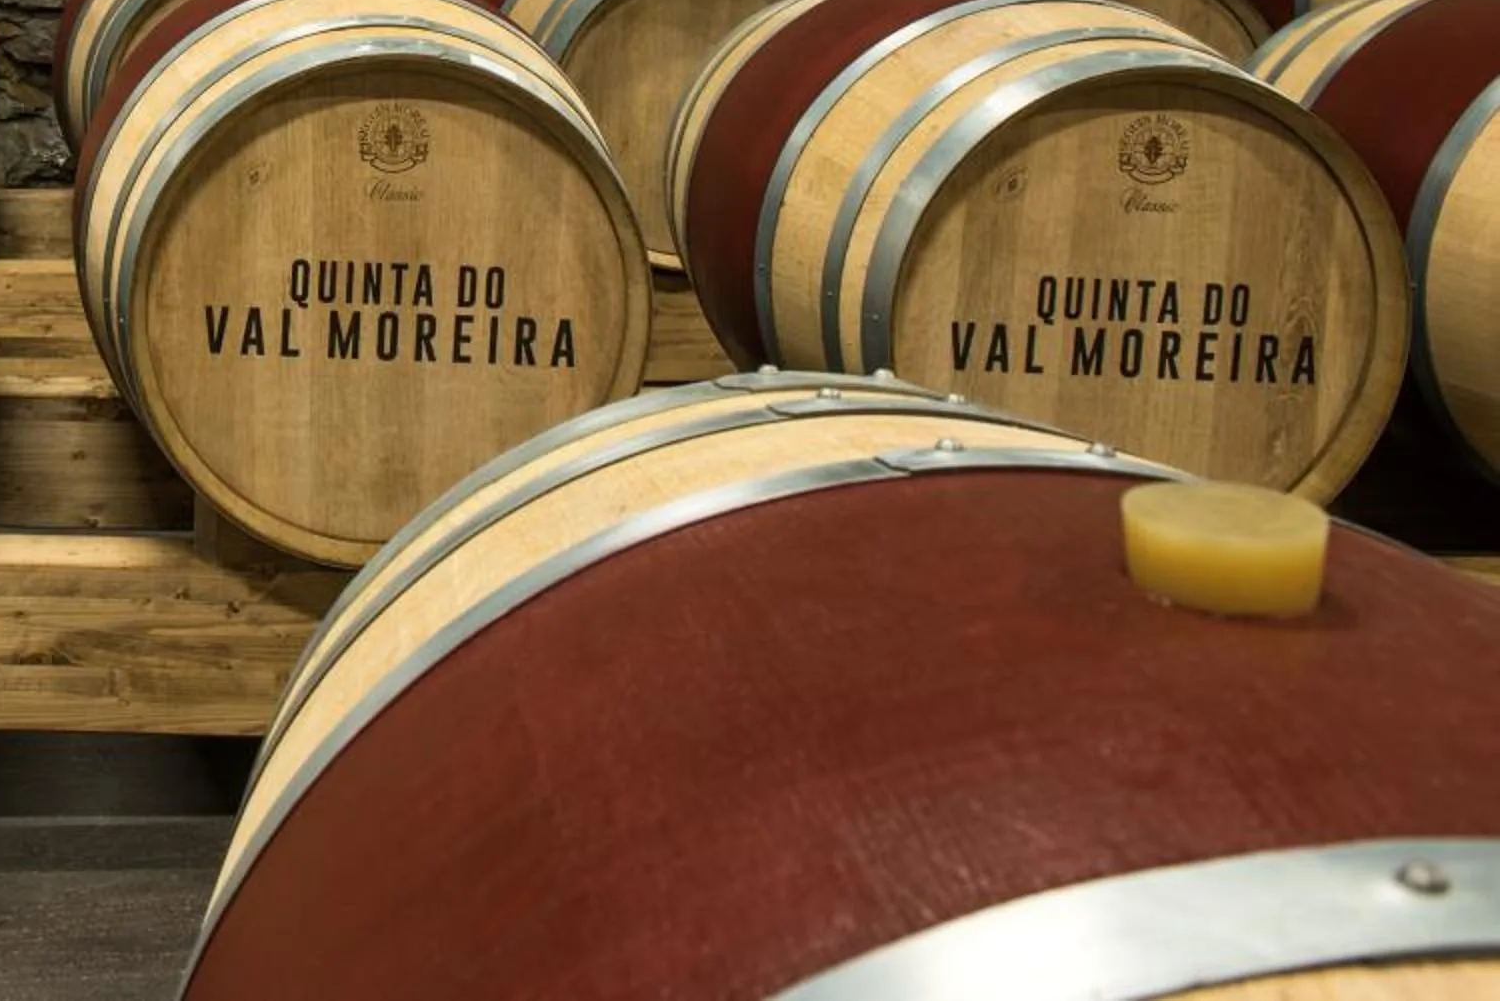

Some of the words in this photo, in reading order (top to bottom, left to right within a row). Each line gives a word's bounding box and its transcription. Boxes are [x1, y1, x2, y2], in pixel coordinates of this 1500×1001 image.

[290, 259, 433, 309] QUINTA
[457, 265, 505, 309] DO
[1037, 276, 1179, 326] QUINTA
[1202, 283, 1250, 328] DO
[205, 305, 300, 357] VAL
[327, 310, 575, 368] MOREIRA
[951, 321, 1044, 374] VAL
[1071, 326, 1316, 386] MOREIRA
